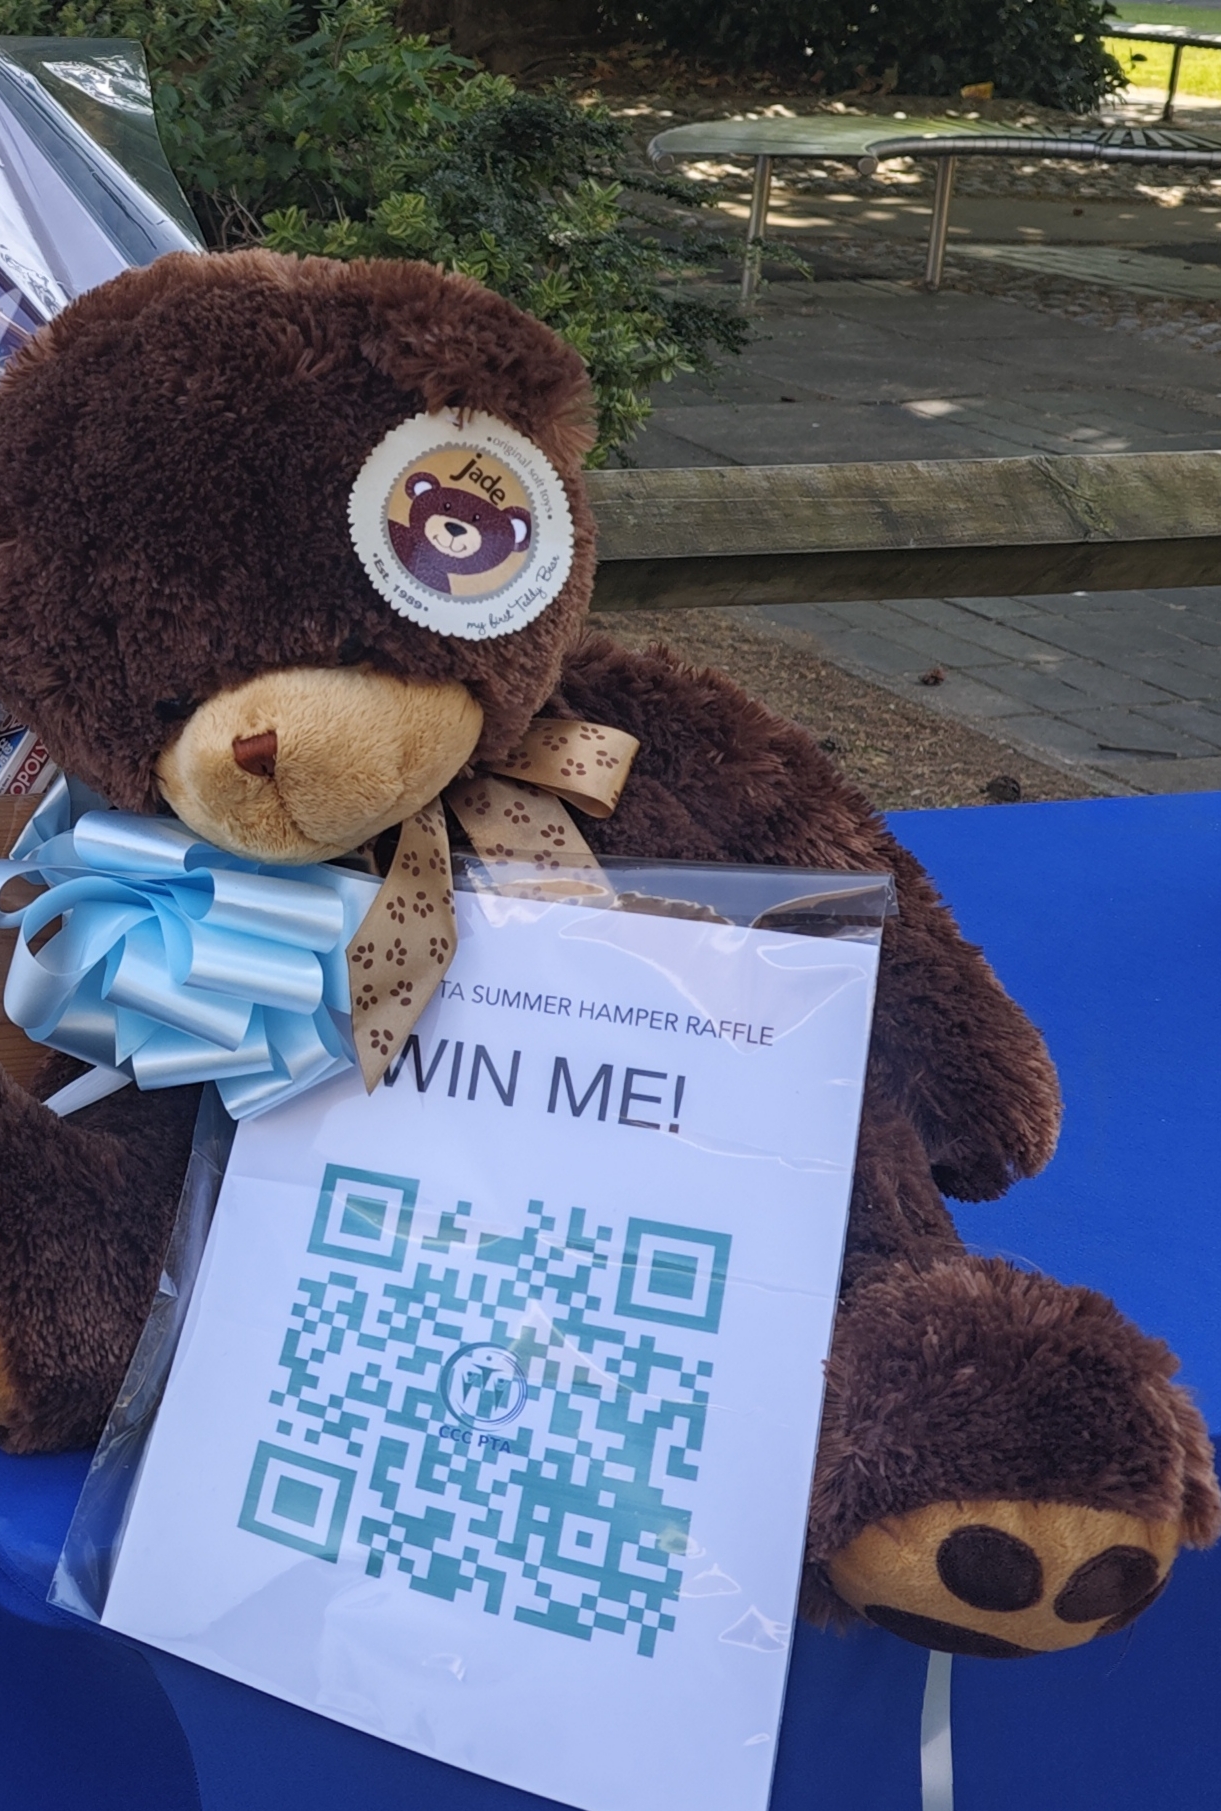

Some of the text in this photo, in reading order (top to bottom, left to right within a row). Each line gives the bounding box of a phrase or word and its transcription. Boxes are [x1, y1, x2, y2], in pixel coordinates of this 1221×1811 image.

[449, 453, 506, 506] jade
[492, 437, 553, 514] original soft toys
[373, 558, 423, 611] Est. 1989
[466, 554, 561, 636] my first Teddy Bear
[10, 739, 49, 795] OPOLY
[440, 979, 775, 1048] TA SUMMER HAMPER RAFFLE
[382, 1034, 686, 1134] WIN ME!
[438, 1425, 511, 1454] CCC PTA
